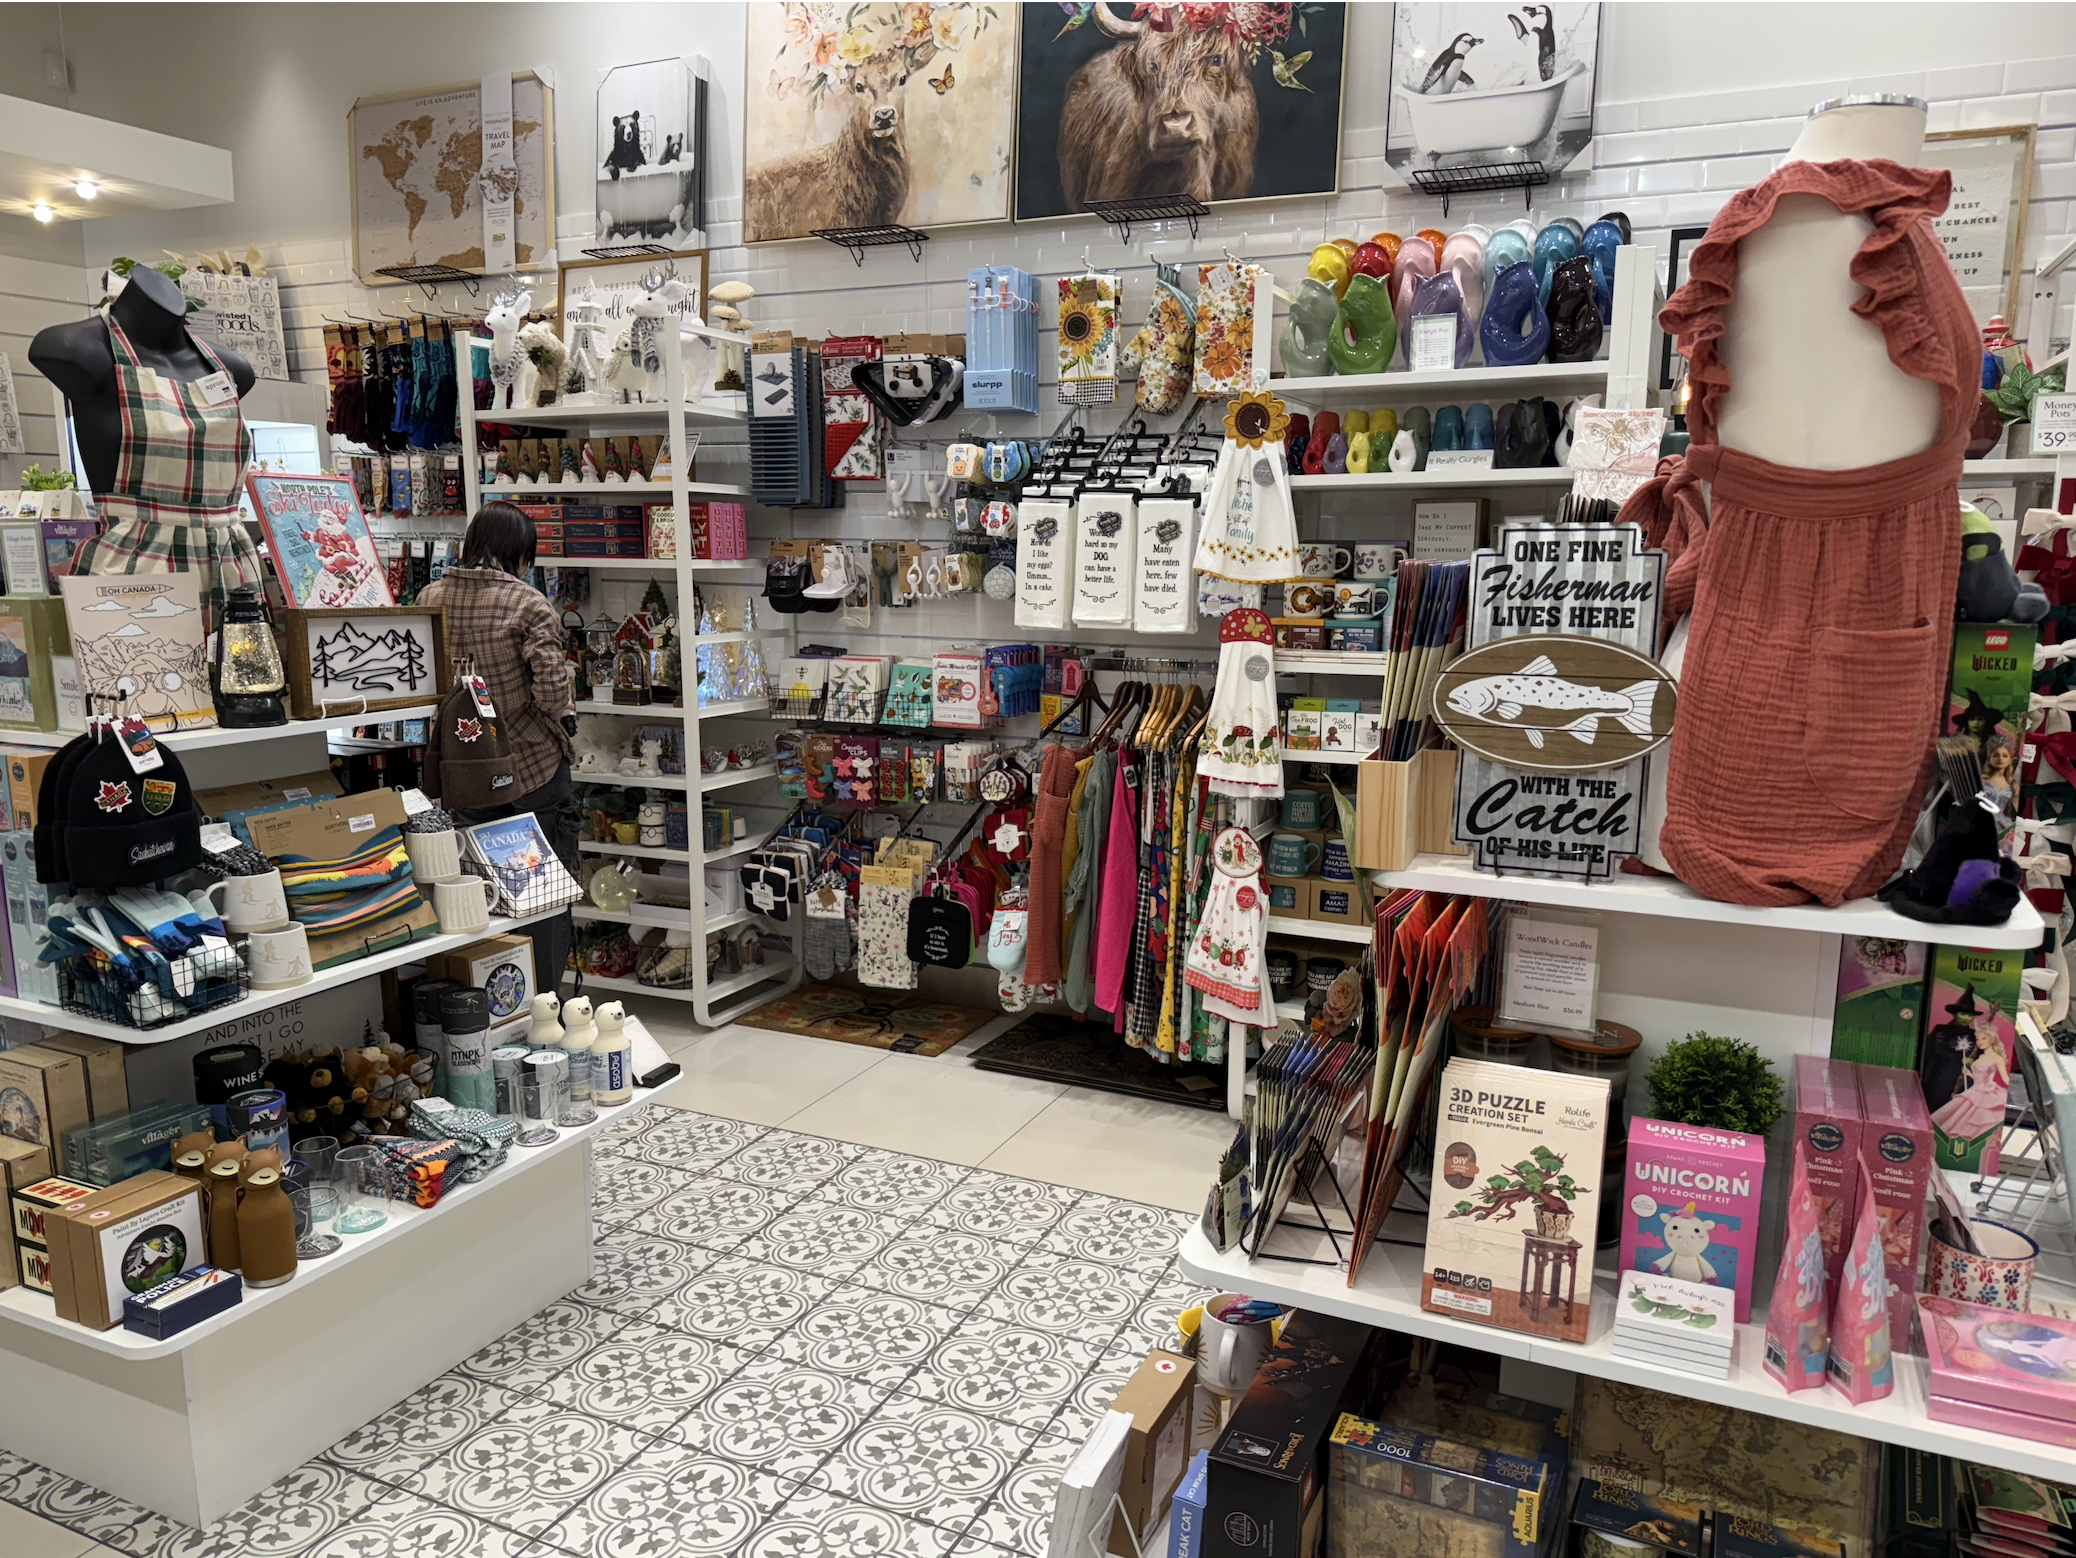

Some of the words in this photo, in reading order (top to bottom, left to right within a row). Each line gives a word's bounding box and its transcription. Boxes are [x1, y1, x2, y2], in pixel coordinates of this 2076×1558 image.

[444, 92, 476, 102] ADVENTURE
[485, 131, 510, 140] TRAVEL
[490, 140, 505, 149] MAP
[1954, 202, 1980, 210] BEST
[1946, 216, 1997, 226] CHANCES
[605, 294, 623, 320] all
[667, 288, 700, 321] night
[216, 312, 246, 320] wisted
[205, 380, 225, 391] apron
[972, 381, 1003, 389] slurpp
[2044, 401, 2076, 412] Money
[1436, 457, 1457, 465] Really
[1459, 455, 1487, 464] Gurgles
[280, 483, 306, 495] NORTH
[308, 483, 332, 495] POLE'S
[266, 491, 299, 516] Ski
[298, 492, 354, 524] Lodge
[1085, 540, 1099, 548] hard
[1109, 542, 1118, 550] my
[1153, 545, 1173, 554] Many
[1514, 540, 1560, 562] ONE
[1568, 541, 1622, 562] FINE
[1094, 552, 1109, 561] DOG
[1144, 558, 1160, 566] have
[1097, 564, 1110, 572] have
[1085, 575, 1102, 583] better
[1481, 564, 1654, 607] Fisherman
[108, 587, 120, 595] OH
[122, 586, 157, 594] CANADA
[1039, 583, 1053, 591] cake.
[1144, 584, 1159, 592] have
[1162, 584, 1178, 593] died.
[1492, 607, 1560, 628] LIVES
[1569, 608, 1636, 629] HERE
[1986, 636, 2007, 645] LEGO
[1972, 654, 2017, 672] WICKED
[60, 678, 78, 692] Smile
[1521, 776, 1569, 797] WITH
[1576, 779, 1617, 799] THE
[100, 789, 129, 808] CANADA
[1466, 778, 1632, 837] Catch
[479, 832, 491, 840] SKI
[483, 831, 526, 850] CANADA
[130, 837, 174, 864] Saskatchewan
[1487, 837, 1507, 854] OF
[1518, 839, 1552, 859] HIS
[1560, 842, 1605, 863] LIFE
[1516, 933, 1560, 945] WoodWick
[1562, 939, 1592, 950] Candles
[1958, 954, 2003, 973] WICKED
[204, 1024, 238, 1045] AND
[242, 1012, 274, 1033] INTO
[278, 1002, 302, 1019] THE
[451, 1050, 480, 1061] MTNPK
[612, 1054, 620, 1089] asobu
[223, 1071, 257, 1089] WINE
[1450, 1087, 1473, 1103] 3D
[1478, 1091, 1546, 1115] PUZZLE
[1449, 1103, 1504, 1121] CREATION
[1507, 1112, 1529, 1124] SET
[1565, 1106, 1591, 1118] Rolife
[1472, 1118, 1504, 1129] Evergreen
[1506, 1123, 1520, 1131] Pine
[1521, 1126, 1543, 1135] Bonsai
[1556, 1116, 1576, 1127] Hands
[1578, 1119, 1596, 1129] Craft
[141, 1125, 181, 1146] villager
[1646, 1124, 1746, 1147] UNICORN
[1810, 1132, 1841, 1142] villager
[1672, 1136, 1717, 1146] CROCHET
[1721, 1142, 1737, 1150] KIT
[1881, 1142, 1913, 1153] villager
[1452, 1157, 1467, 1165] DIY
[1698, 1160, 1723, 1168] KROCHET
[1815, 1157, 1832, 1165] Pink
[1873, 1173, 1914, 1185] Christmas
[1885, 1168, 1903, 1176] Pink
[1635, 1162, 1750, 1197] UNICORN
[1823, 1180, 1840, 1188] rose
[1670, 1189, 1712, 1202] CROCHET
[1873, 1187, 1891, 1196] Noël
[1893, 1190, 1911, 1199] rose
[112, 1225, 128, 1235] Paint
[130, 1221, 138, 1229] By
[139, 1211, 160, 1226] Layers
[160, 1204, 174, 1215] Craft
[175, 1199, 185, 1208] Kit
[117, 1227, 140, 1239] Adventure
[157, 1214, 172, 1222] Shadow
[131, 1277, 181, 1301] GRAMMAR
[136, 1279, 190, 1303] POLICE
[1334, 1415, 1350, 1440] AQUARIUS
[1377, 1442, 1411, 1458] 1000
[1194, 1470, 1205, 1489] SPEAK
[1186, 1487, 1196, 1499] CAT
[1592, 1489, 1639, 1511] RINGS
[1182, 1508, 1193, 1531] CAT
[1525, 1497, 1534, 1538] AQUARIUS
[1728, 1523, 1778, 1546] RINGS
[1177, 1532, 1190, 1558] PEAK
